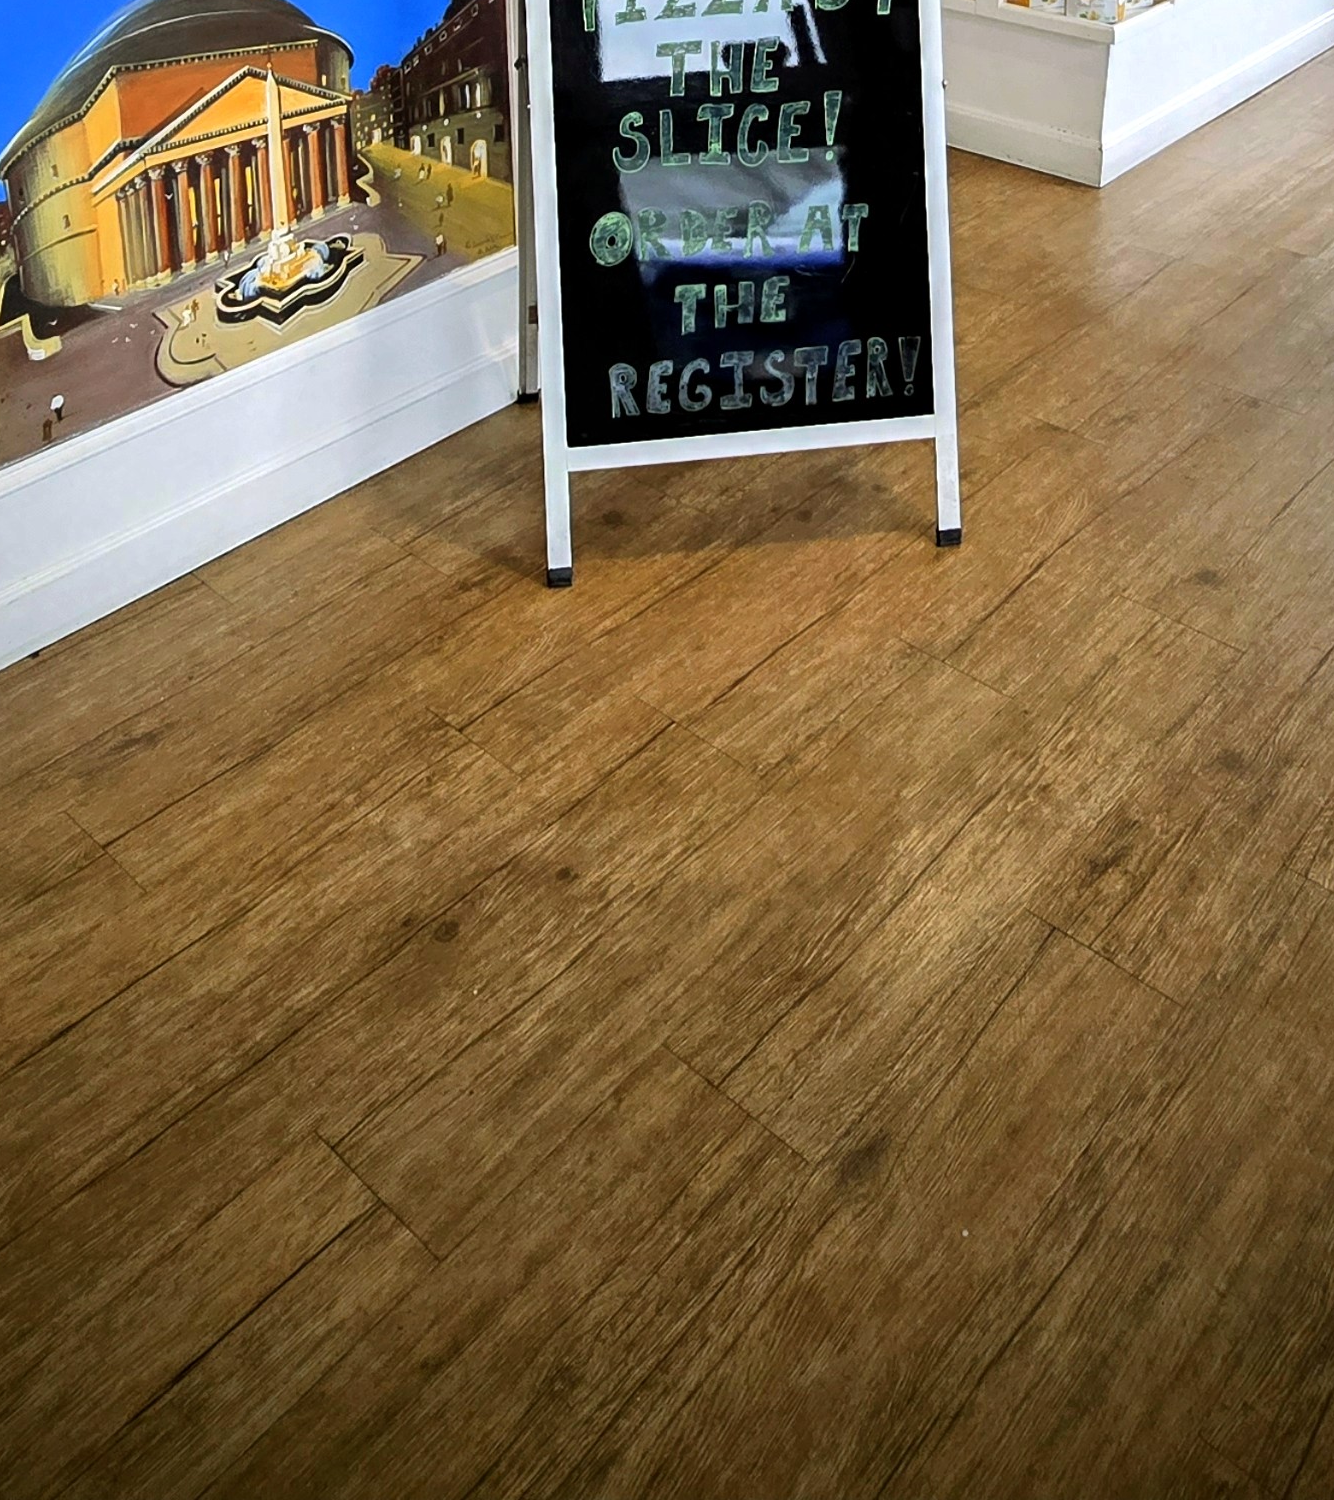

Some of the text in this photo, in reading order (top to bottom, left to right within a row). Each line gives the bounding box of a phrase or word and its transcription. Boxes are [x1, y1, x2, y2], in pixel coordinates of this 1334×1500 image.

[655, 36, 782, 97] THE
[612, 90, 843, 173] SLICE!
[589, 201, 869, 267] ORDER AT
[674, 275, 790, 336] THE
[609, 335, 921, 418] REGISTER!
